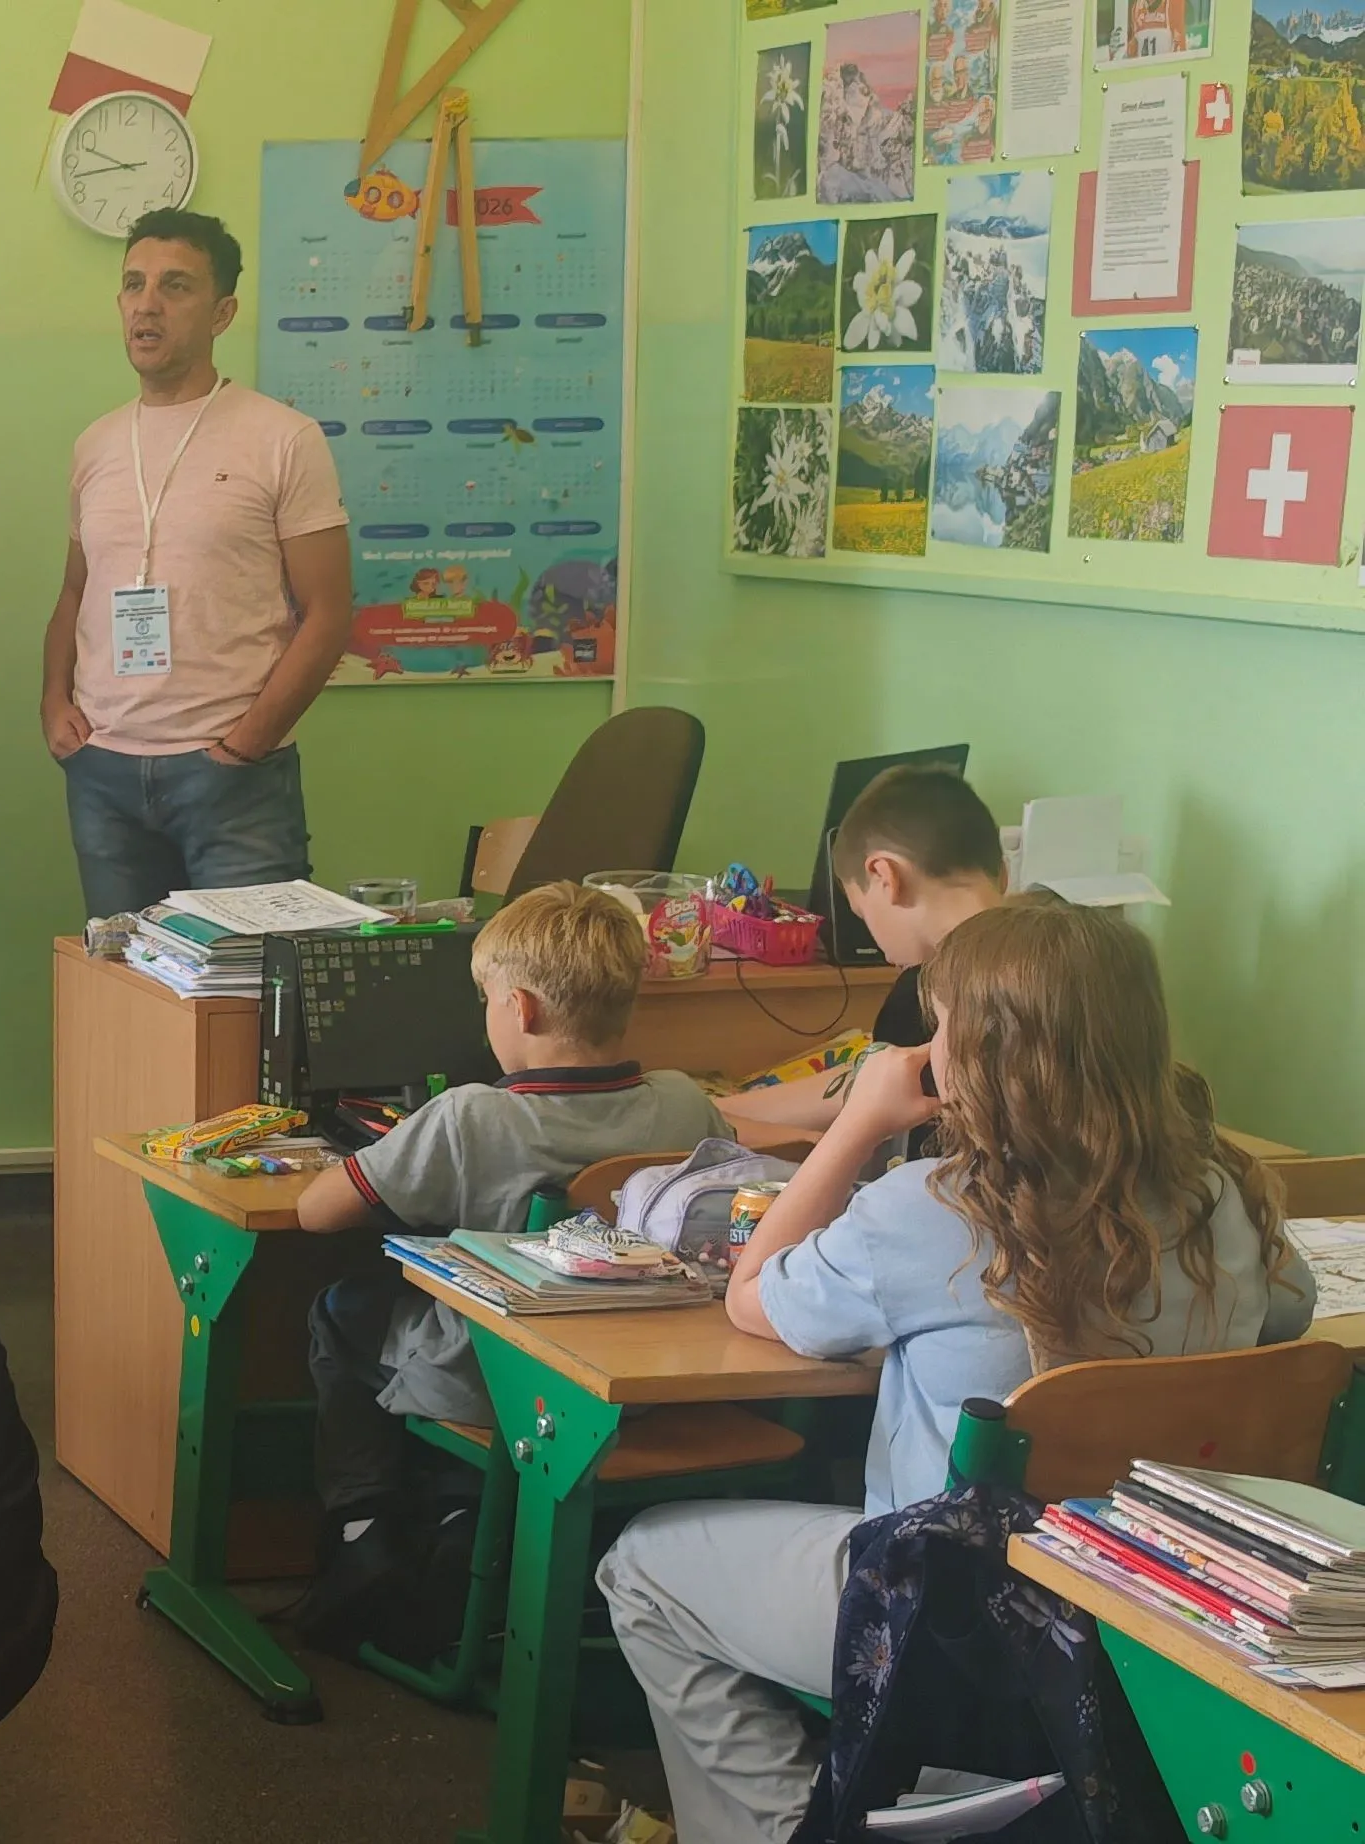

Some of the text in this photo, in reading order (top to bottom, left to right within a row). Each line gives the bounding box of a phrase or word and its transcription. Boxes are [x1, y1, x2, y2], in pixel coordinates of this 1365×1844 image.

[99, 108, 108, 132] 11
[118, 101, 138, 126] 12
[76, 130, 96, 151] 10
[164, 128, 178, 152] 2
[66, 154, 79, 177] 9
[173, 155, 186, 178] 3
[72, 181, 86, 204] 8
[161, 180, 174, 203] 4
[93, 199, 108, 222] 7
[116, 206, 131, 230] 6
